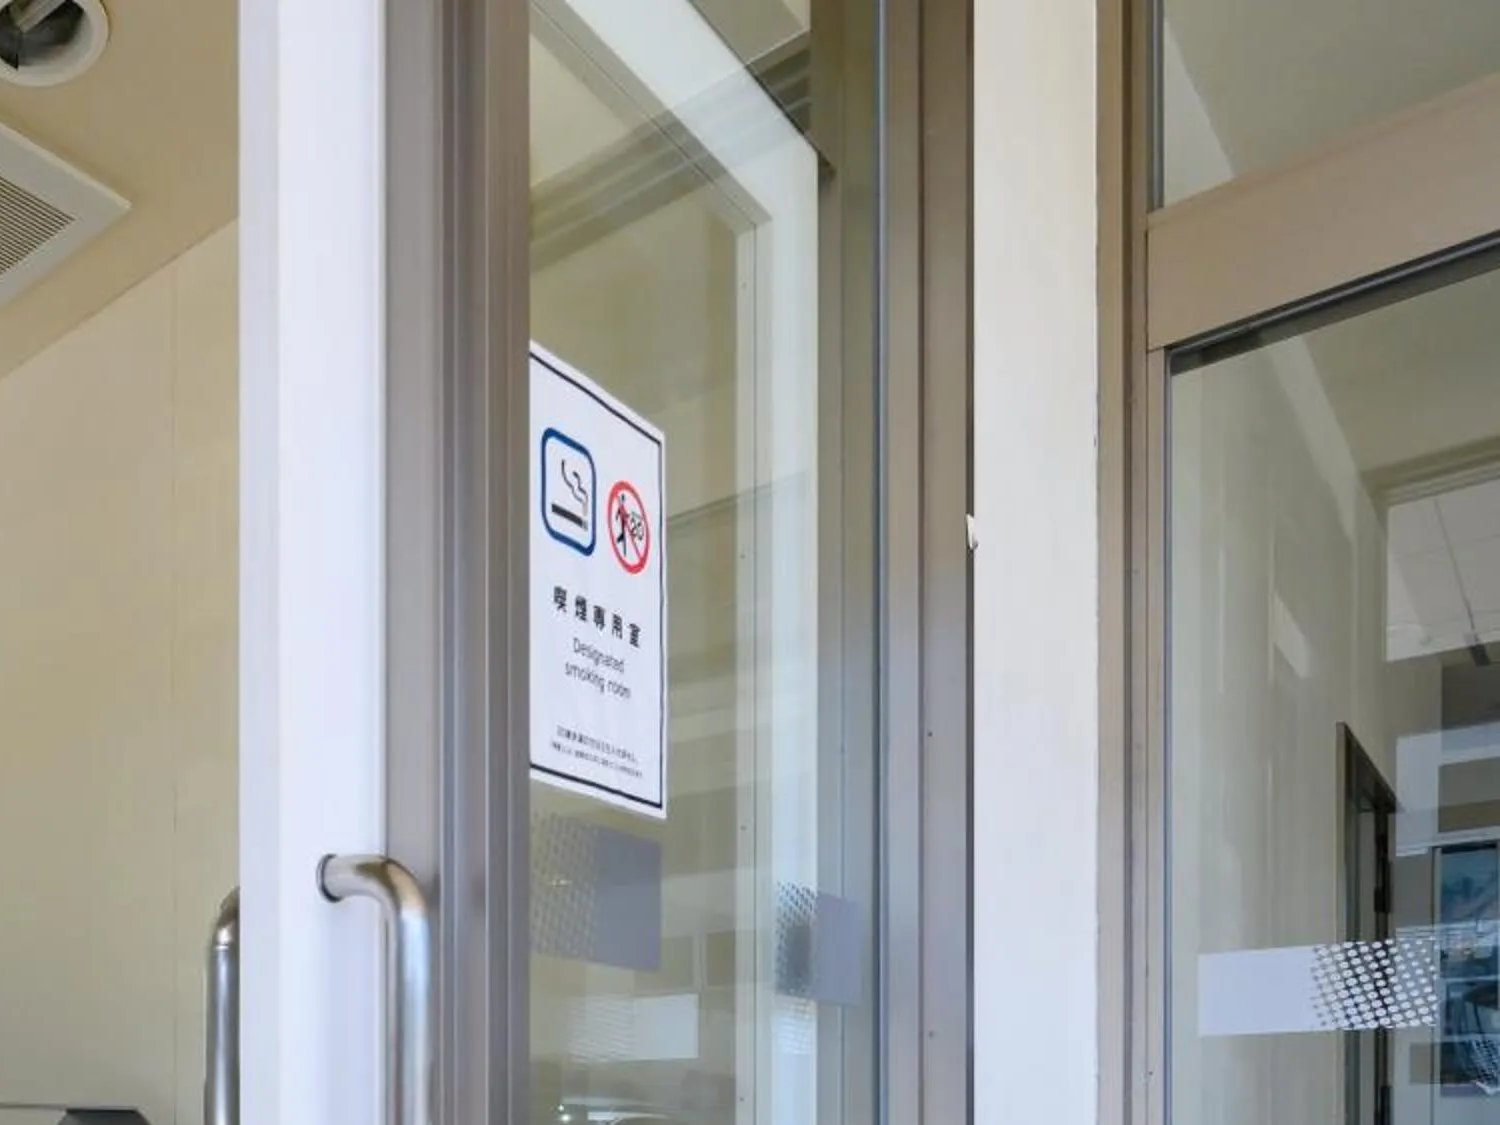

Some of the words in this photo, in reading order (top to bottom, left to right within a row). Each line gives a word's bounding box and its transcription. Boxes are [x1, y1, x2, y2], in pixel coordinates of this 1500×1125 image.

[553, 585, 640, 648] 喫煙専用室
[573, 637, 624, 673] Designated
[565, 661, 604, 693] smoking
[607, 681, 631, 699] room
